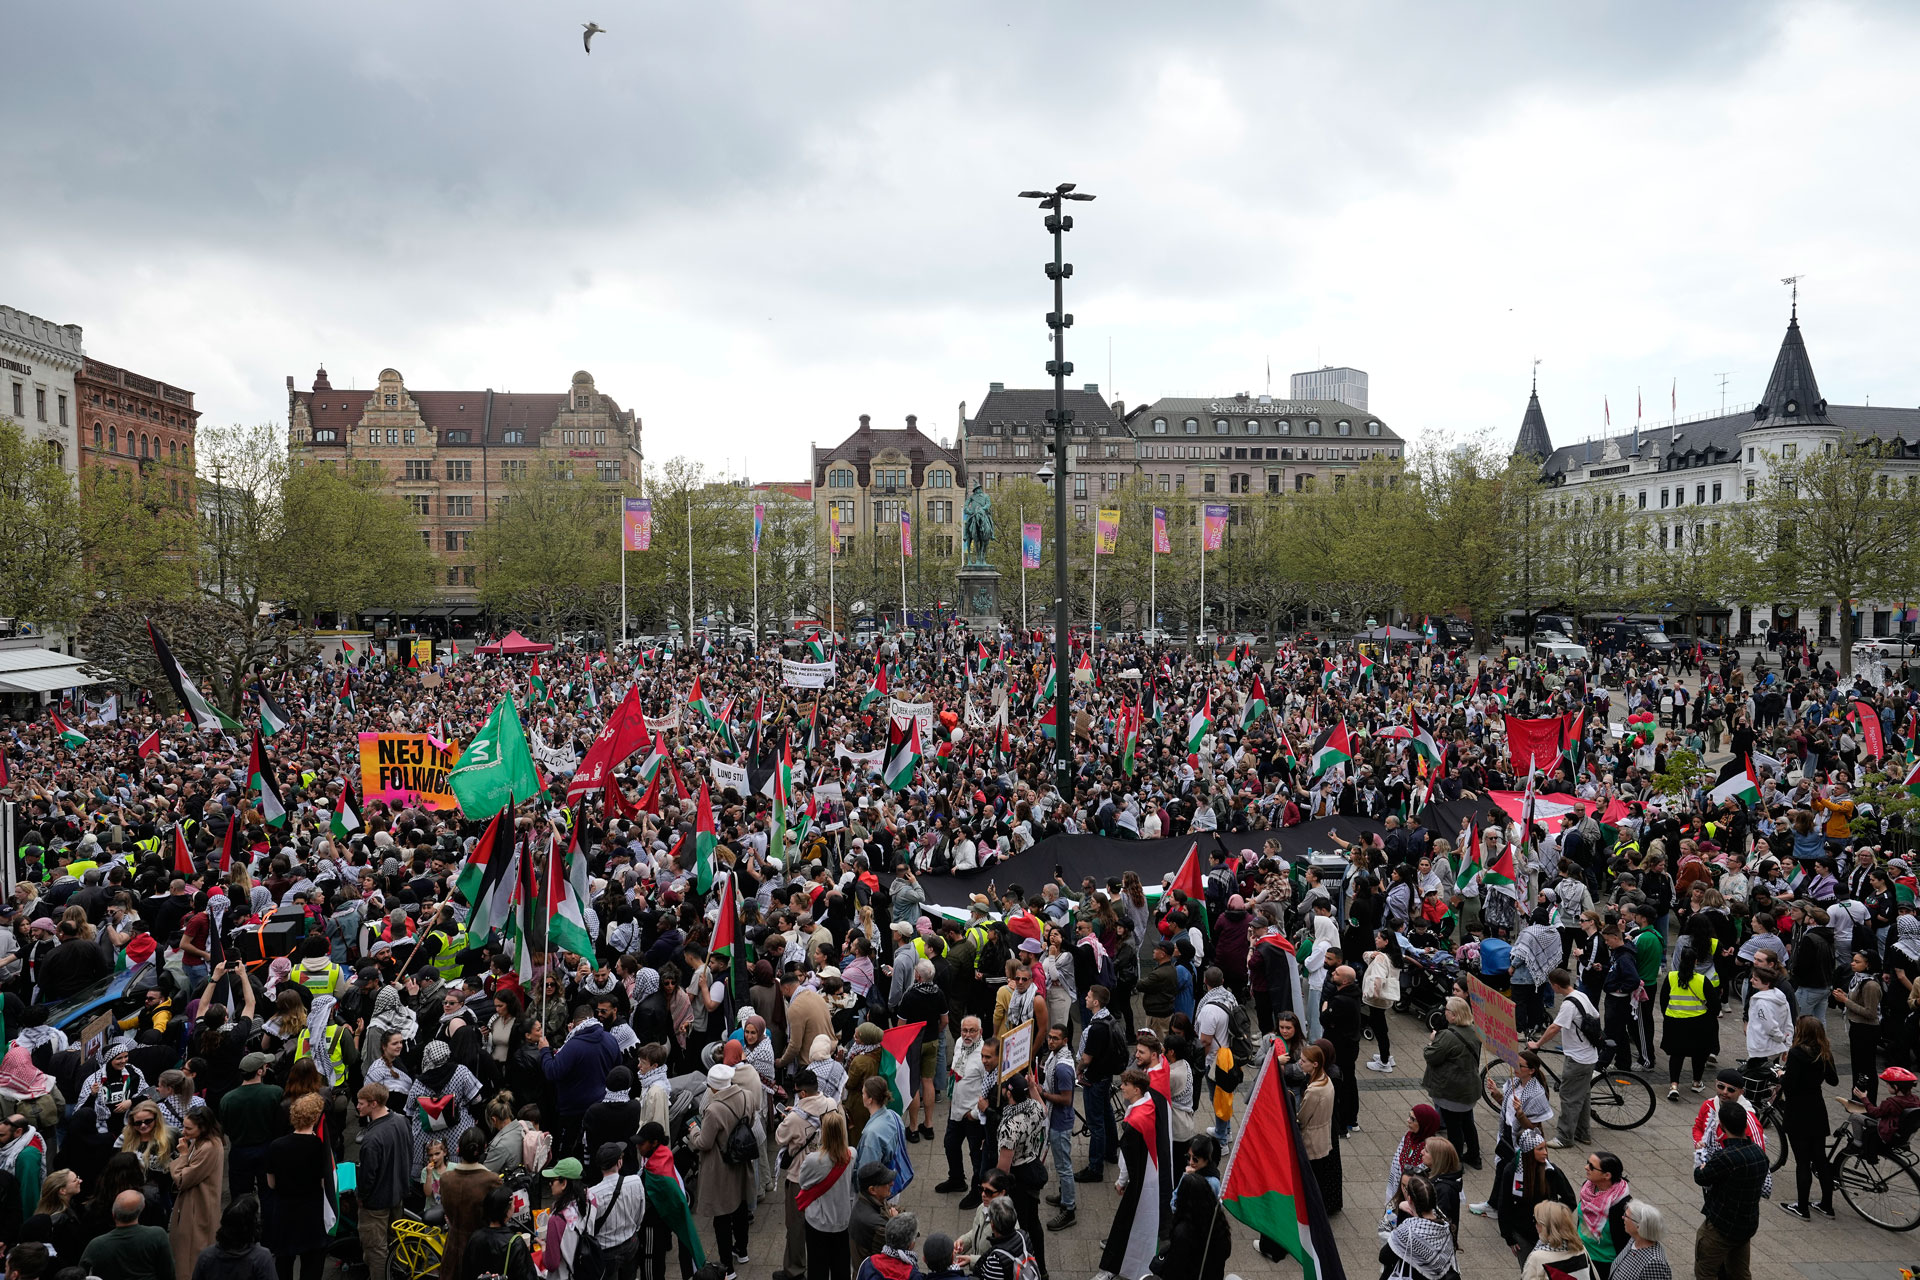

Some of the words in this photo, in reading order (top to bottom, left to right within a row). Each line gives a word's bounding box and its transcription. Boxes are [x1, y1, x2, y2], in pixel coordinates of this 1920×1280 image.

[643, 541, 649, 549] BY
[1103, 531, 1111, 552] UNITED
[1033, 558, 1040, 567] BY
[897, 715, 928, 732] STP
[378, 739, 424, 765] NEJ
[717, 768, 731, 779] LUND
